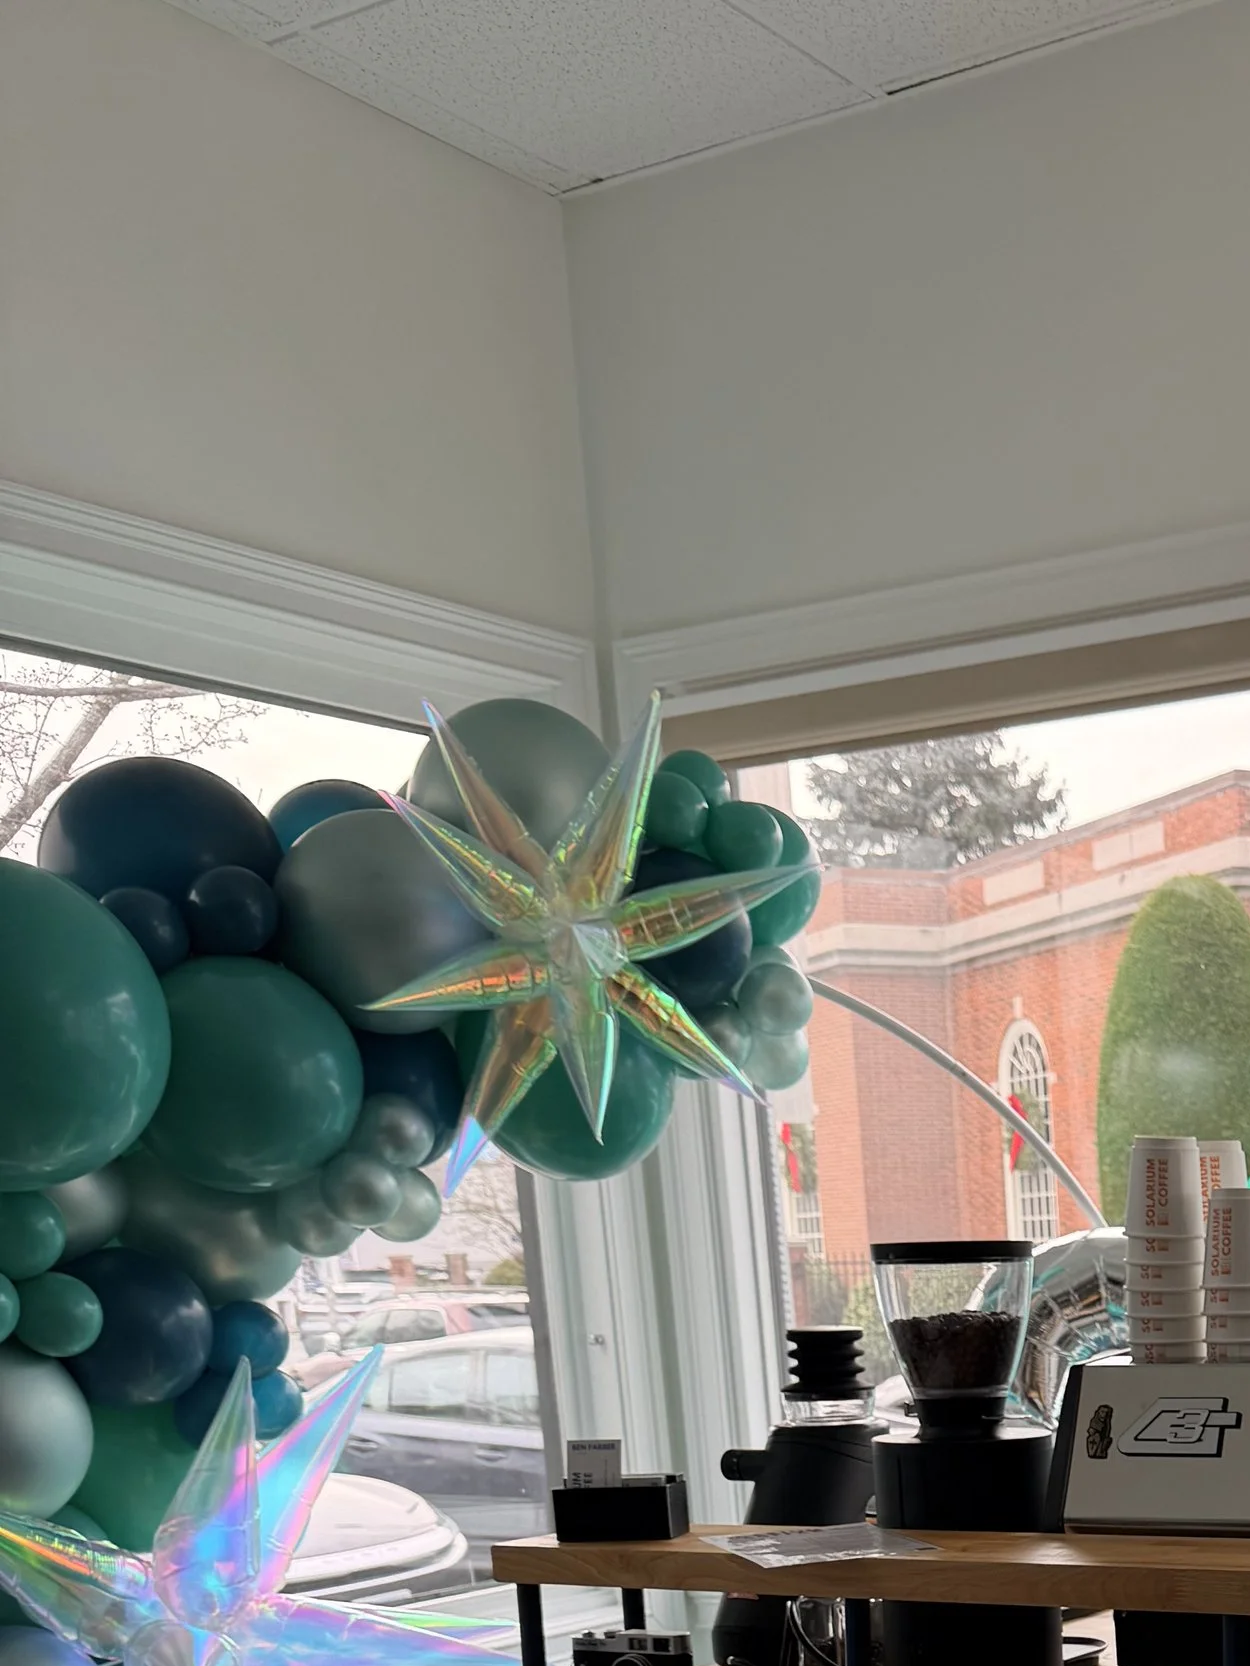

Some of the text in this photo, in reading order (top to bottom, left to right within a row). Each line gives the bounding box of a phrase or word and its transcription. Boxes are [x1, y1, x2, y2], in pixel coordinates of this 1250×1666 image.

[1145, 1158, 1156, 1227] SOLARIUM
[1158, 1158, 1169, 1207] COFFEE
[1211, 1208, 1220, 1276] SOLARIUM
[1222, 1207, 1232, 1256] COFFEE
